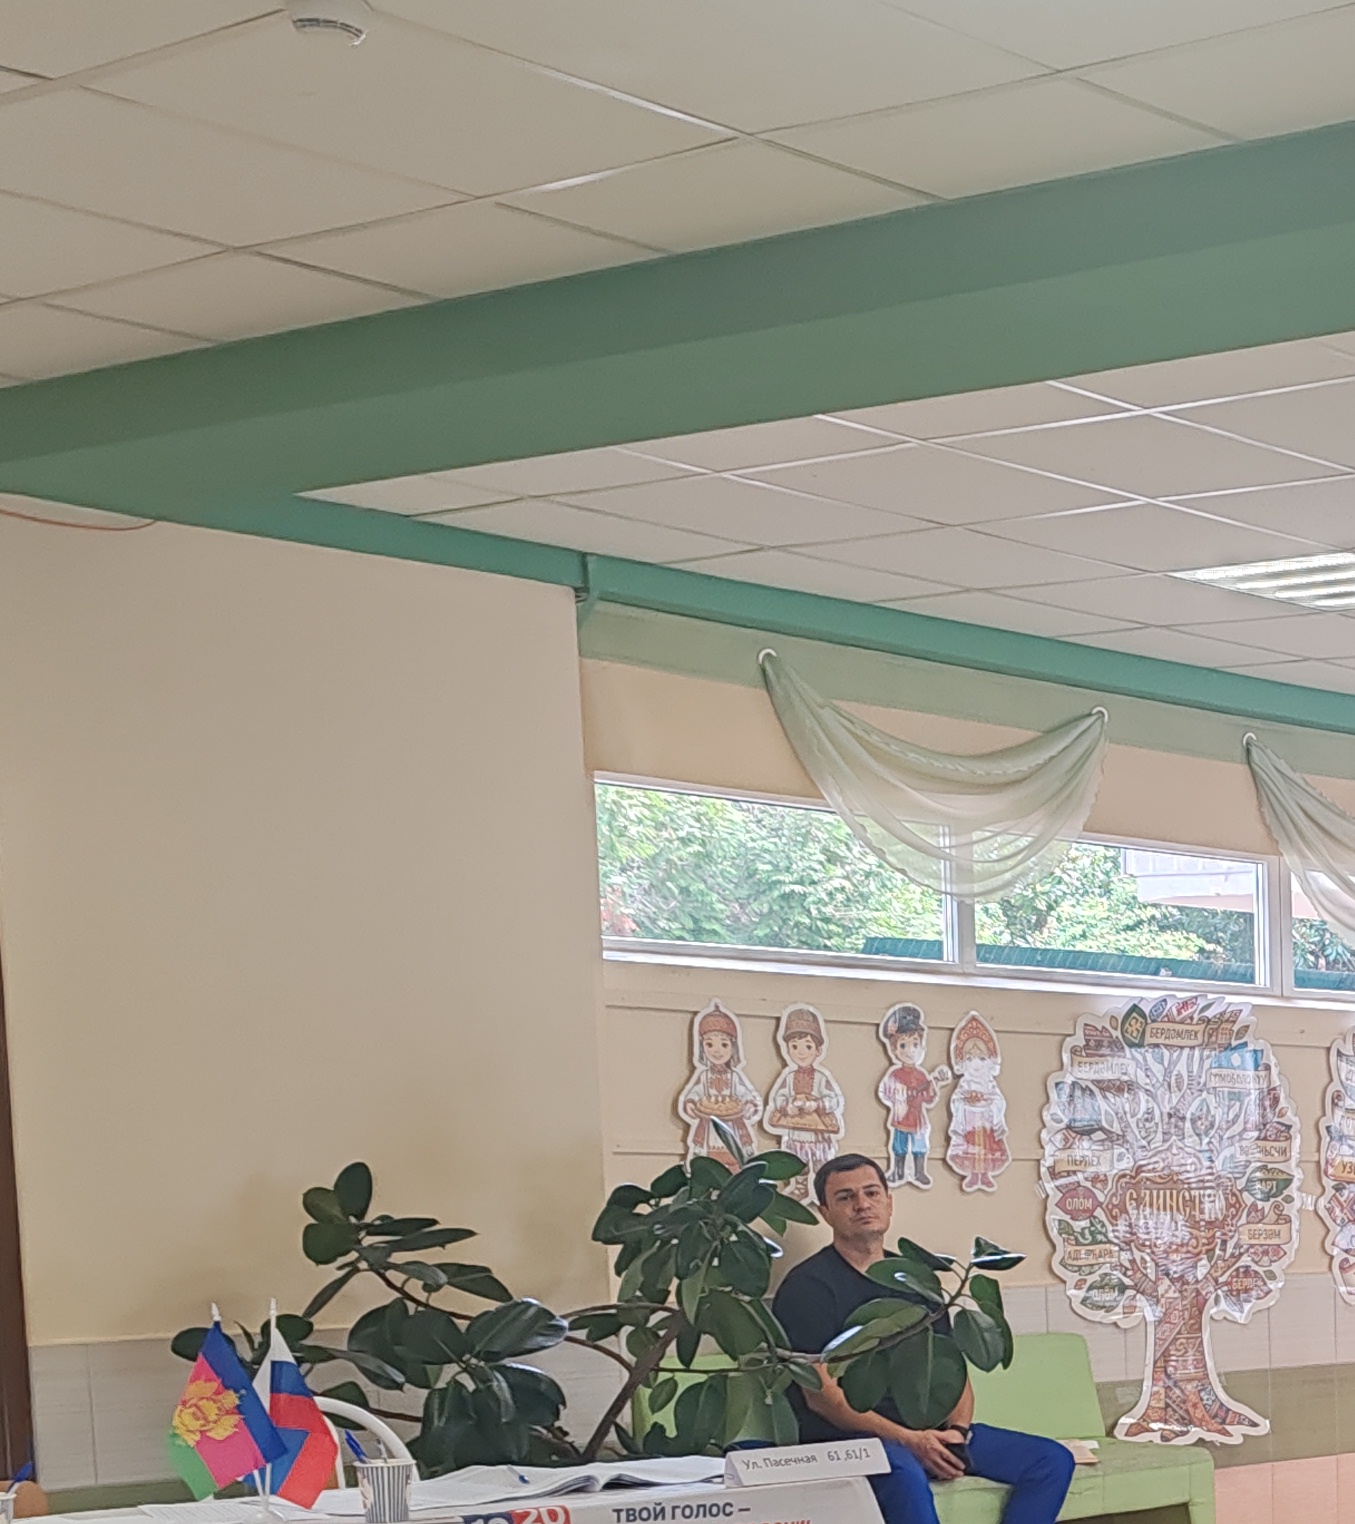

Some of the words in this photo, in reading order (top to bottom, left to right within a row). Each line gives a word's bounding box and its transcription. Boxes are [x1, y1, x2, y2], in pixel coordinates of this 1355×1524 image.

[742, 1458, 762, 1471] Ул.
[764, 1453, 818, 1469] Пасечная
[827, 1450, 841, 1462] 61
[612, 1502, 666, 1524] ТВОЙ
[671, 1501, 734, 1521] ГОЛОС
